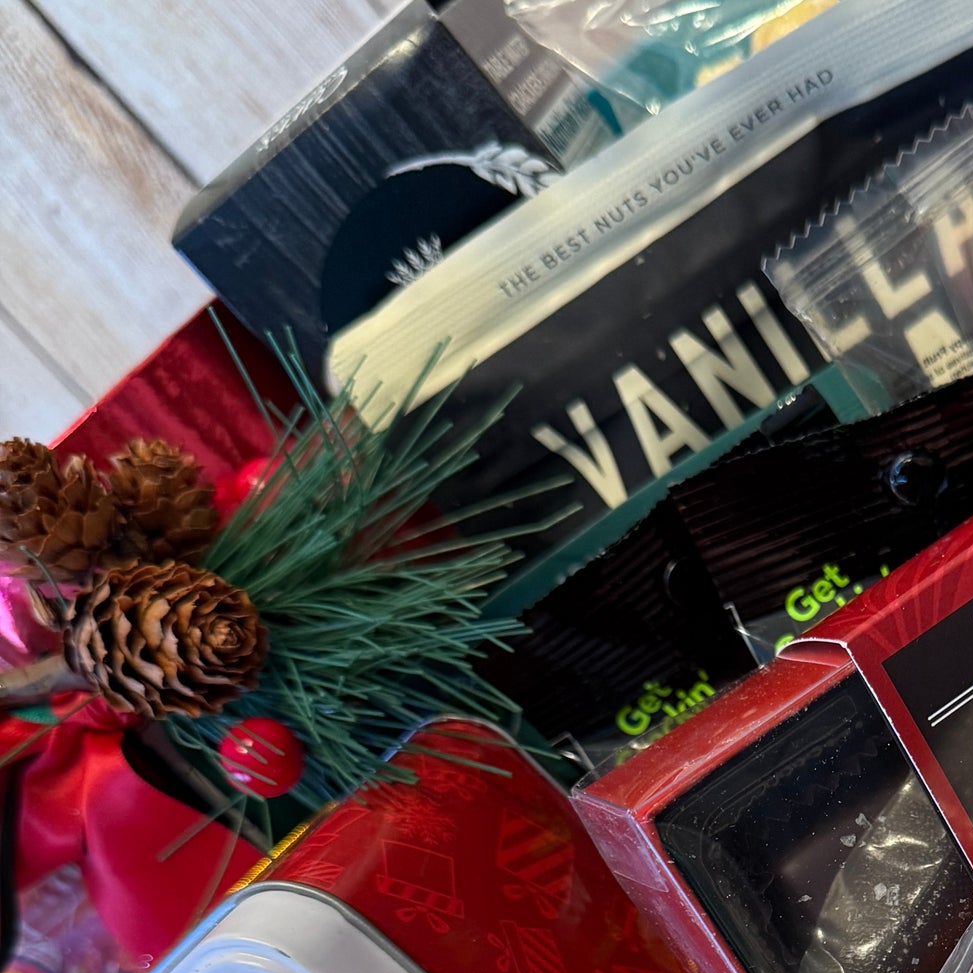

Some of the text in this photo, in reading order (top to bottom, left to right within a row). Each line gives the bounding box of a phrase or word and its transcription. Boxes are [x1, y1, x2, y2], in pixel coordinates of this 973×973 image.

[497, 261, 541, 300] THE
[538, 225, 592, 271] BEST
[591, 186, 649, 234] NUTS
[725, 94, 784, 143] EVER
[787, 68, 835, 108] HAD
[785, 563, 850, 621] Get
[615, 681, 673, 735] Get
